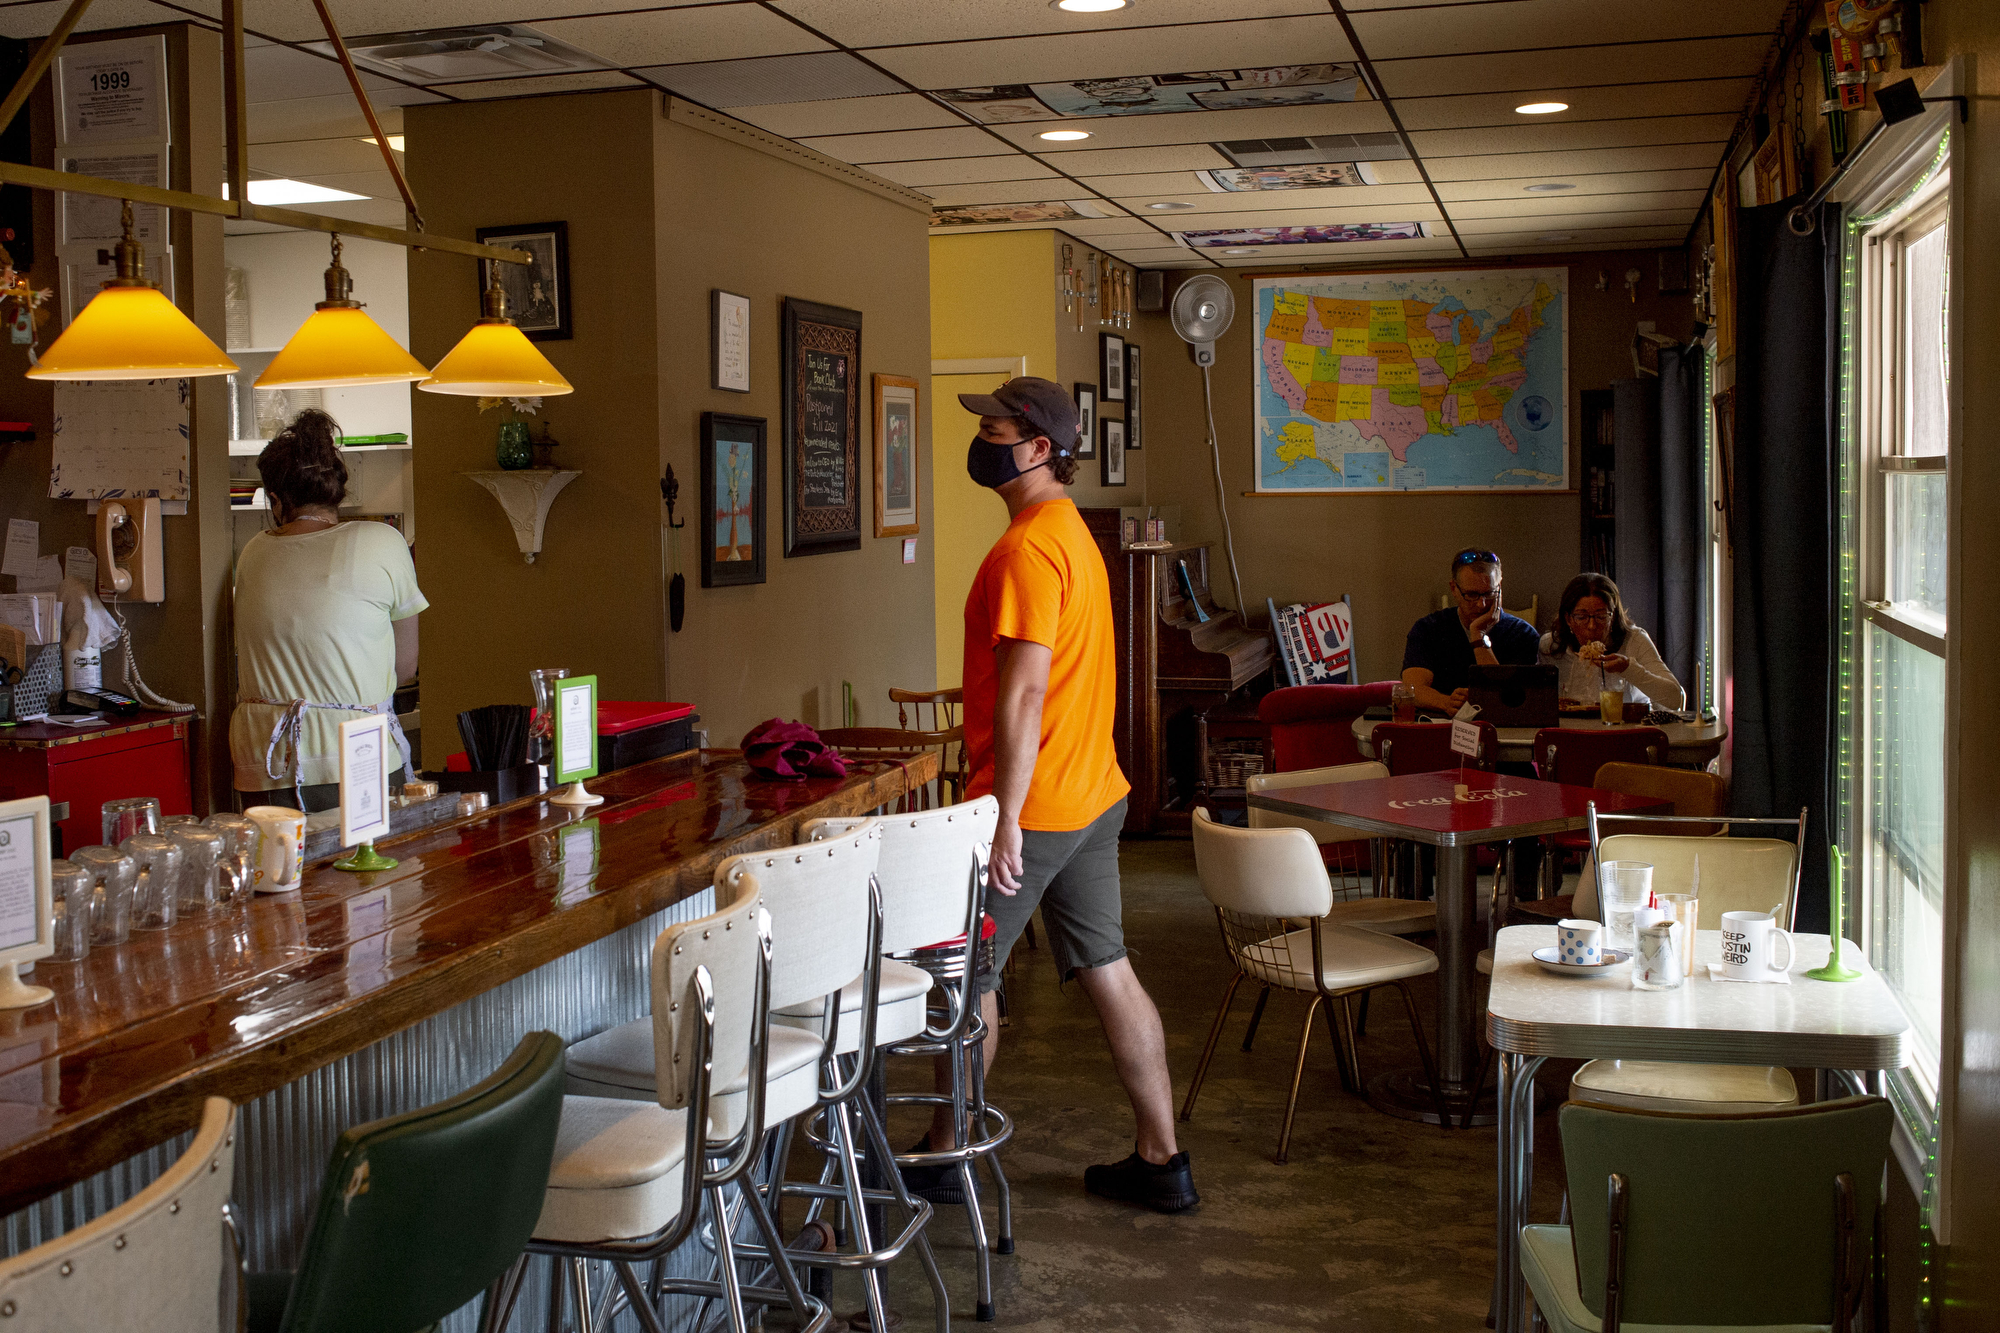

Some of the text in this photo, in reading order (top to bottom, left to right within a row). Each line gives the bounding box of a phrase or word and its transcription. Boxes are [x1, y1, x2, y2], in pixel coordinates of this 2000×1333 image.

[1840, 37, 1854, 62] ESB
[91, 71, 130, 91] 1999
[1844, 62, 1860, 105] AER
[1272, 323, 1300, 332] OREGON
[808, 354, 816, 369] Join
[816, 357, 823, 370] Us
[814, 371, 836, 388] Book Club
[806, 393, 834, 420] Postponed
[824, 420, 838, 435] 2021
[1455, 725, 1476, 737] RESERVED
[1722, 928, 1746, 942] KEEP
[1722, 942, 1751, 954] USTIN
